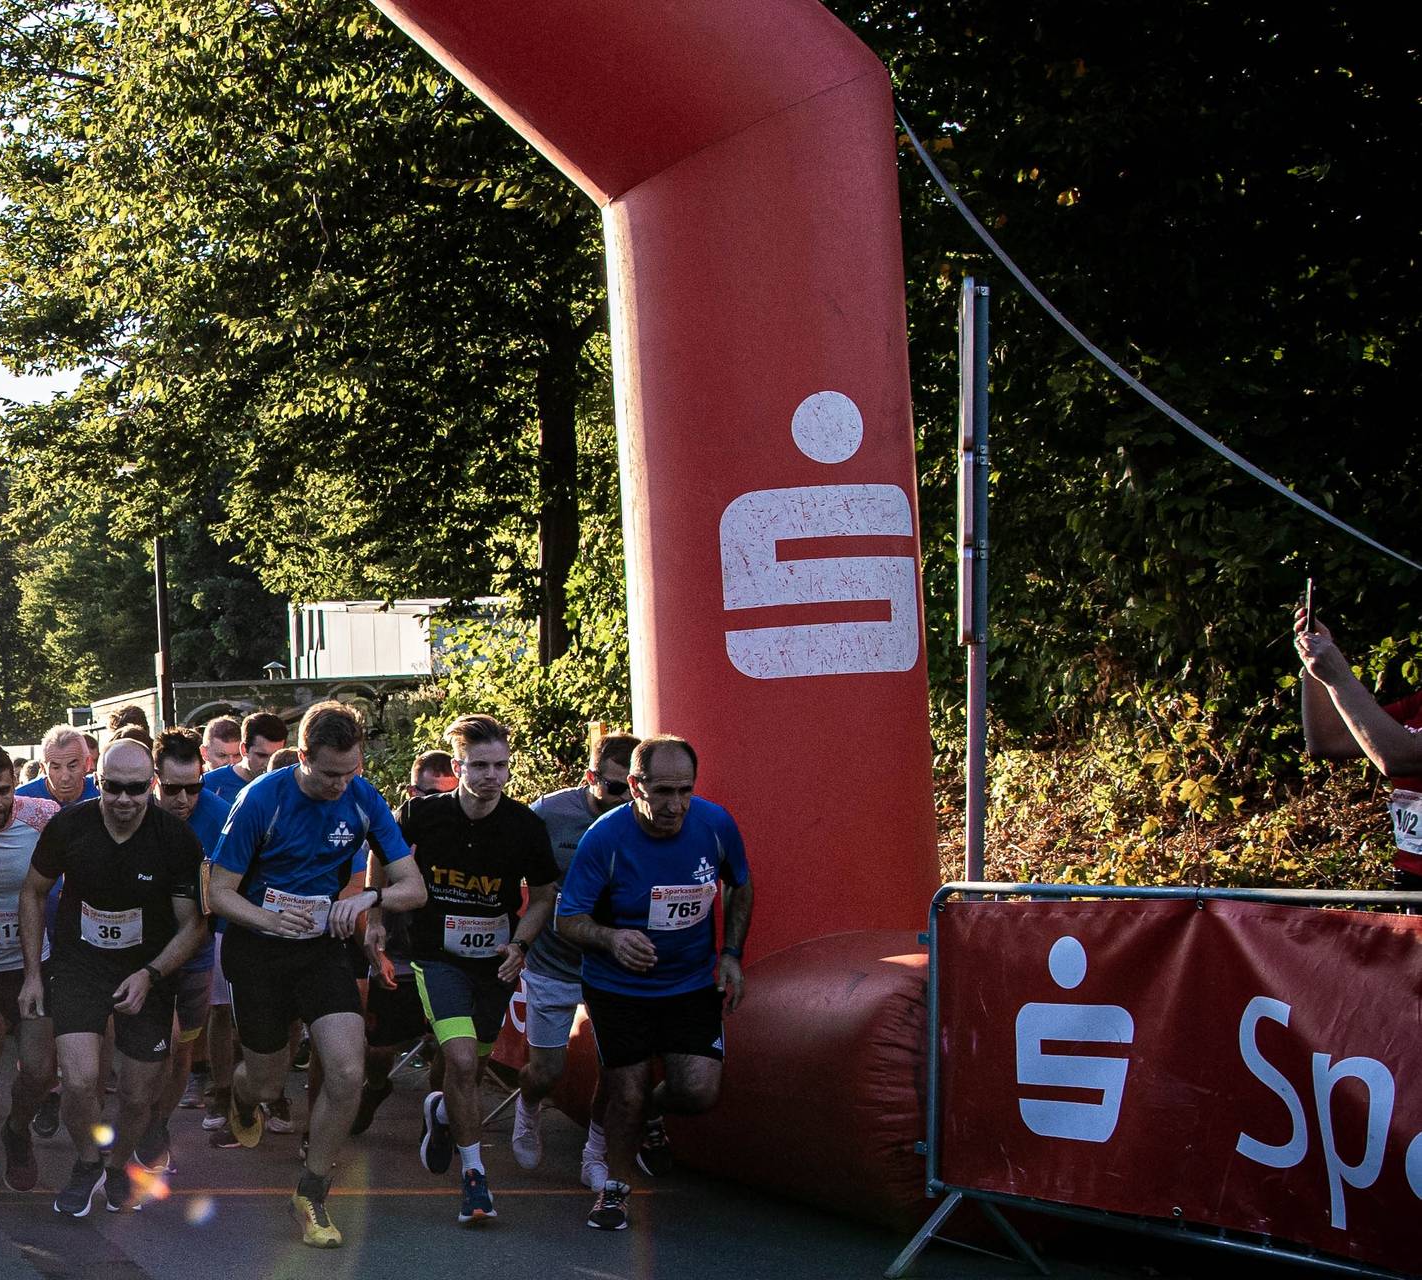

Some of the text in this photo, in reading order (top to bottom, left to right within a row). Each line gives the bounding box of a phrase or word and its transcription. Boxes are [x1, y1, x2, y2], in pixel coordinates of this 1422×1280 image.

[138, 873, 153, 881] Paul
[431, 865, 502, 896] TEAM
[666, 900, 702, 919] 765
[98, 925, 122, 940] 36
[459, 933, 496, 948] 402
[1235, 995, 1422, 1232] Sp
